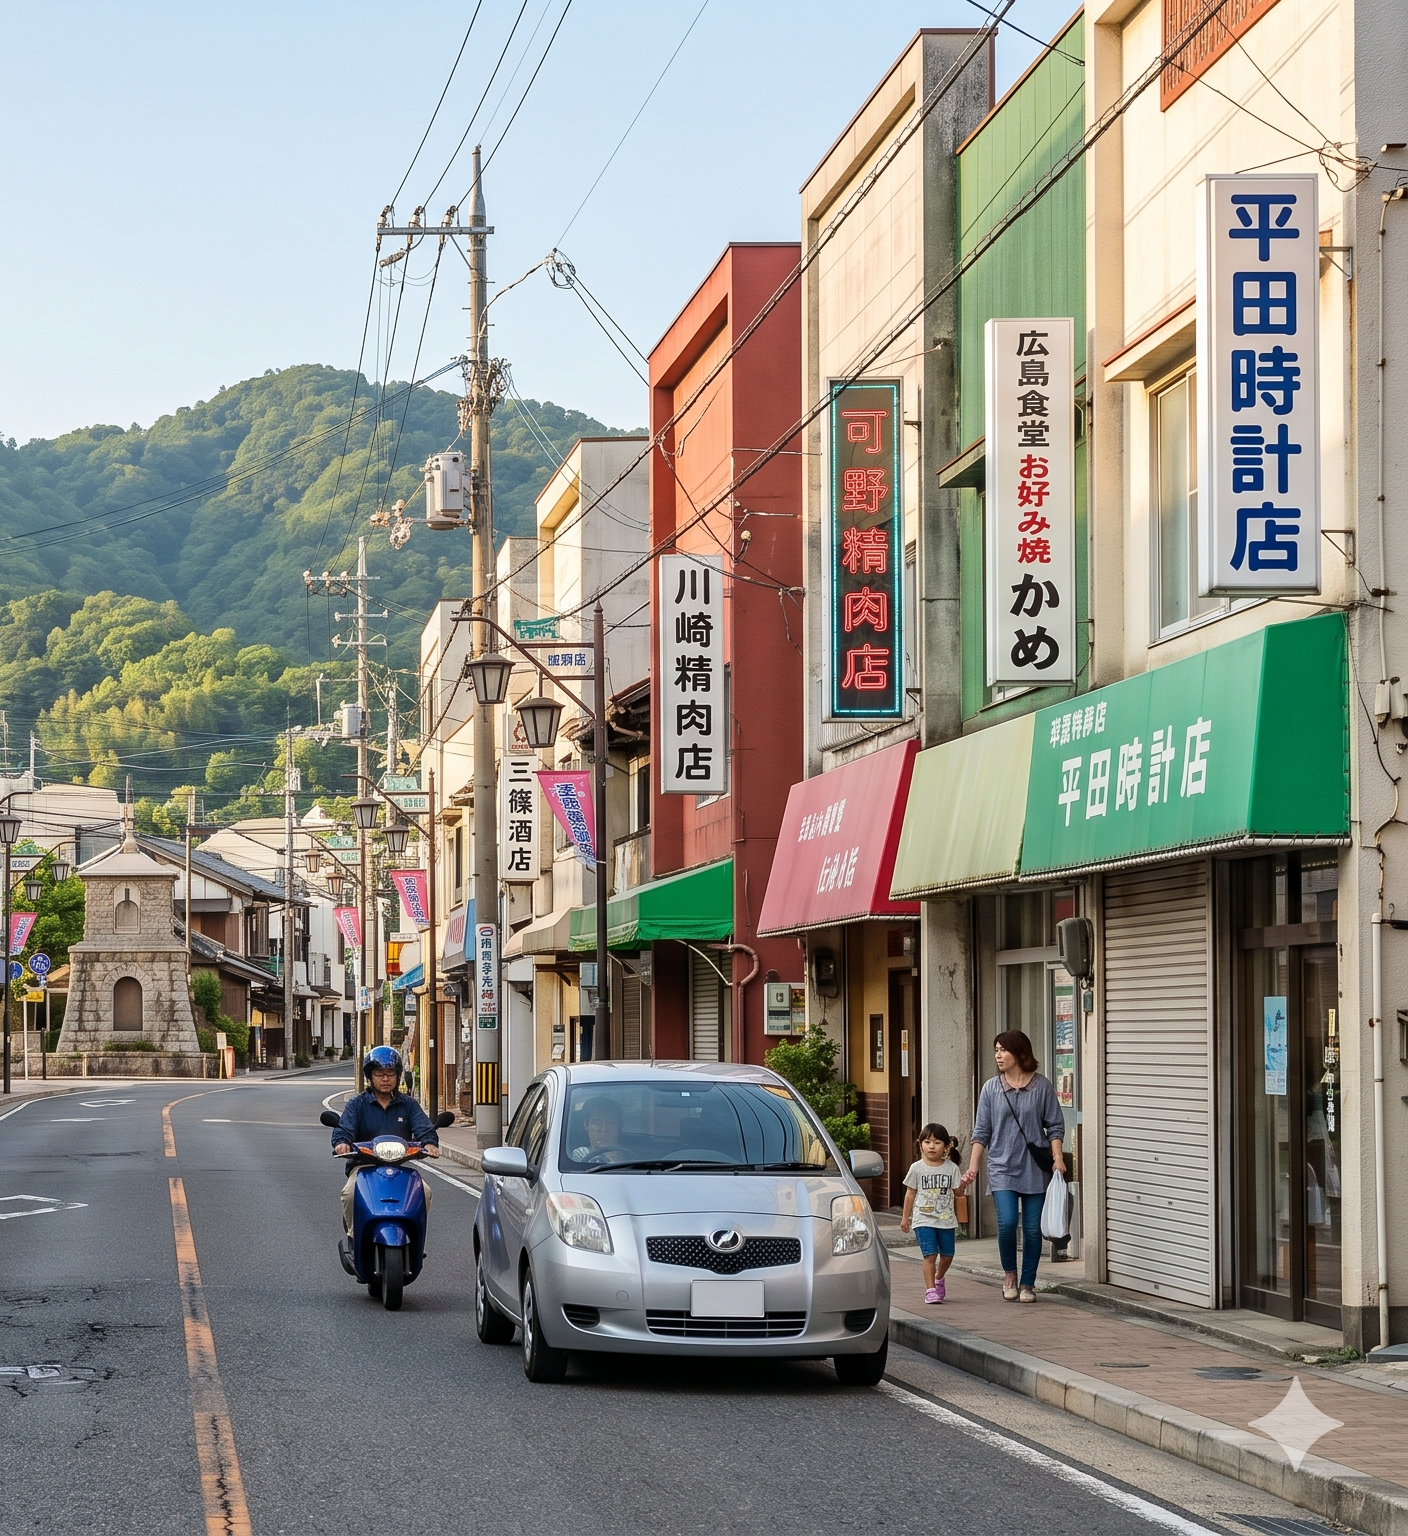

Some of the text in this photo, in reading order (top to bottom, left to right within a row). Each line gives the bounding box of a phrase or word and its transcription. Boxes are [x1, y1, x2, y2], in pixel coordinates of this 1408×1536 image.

[1009, 330, 1060, 671] 広島食堂 お好み焼 かめ
[1228, 193, 1302, 571] 平田時計店
[841, 408, 890, 690] 可野精肉店
[674, 567, 714, 781] 川崎精肉店
[1058, 716, 1212, 827] 平田時計店
[508, 762, 533, 872] 三篠酒店
